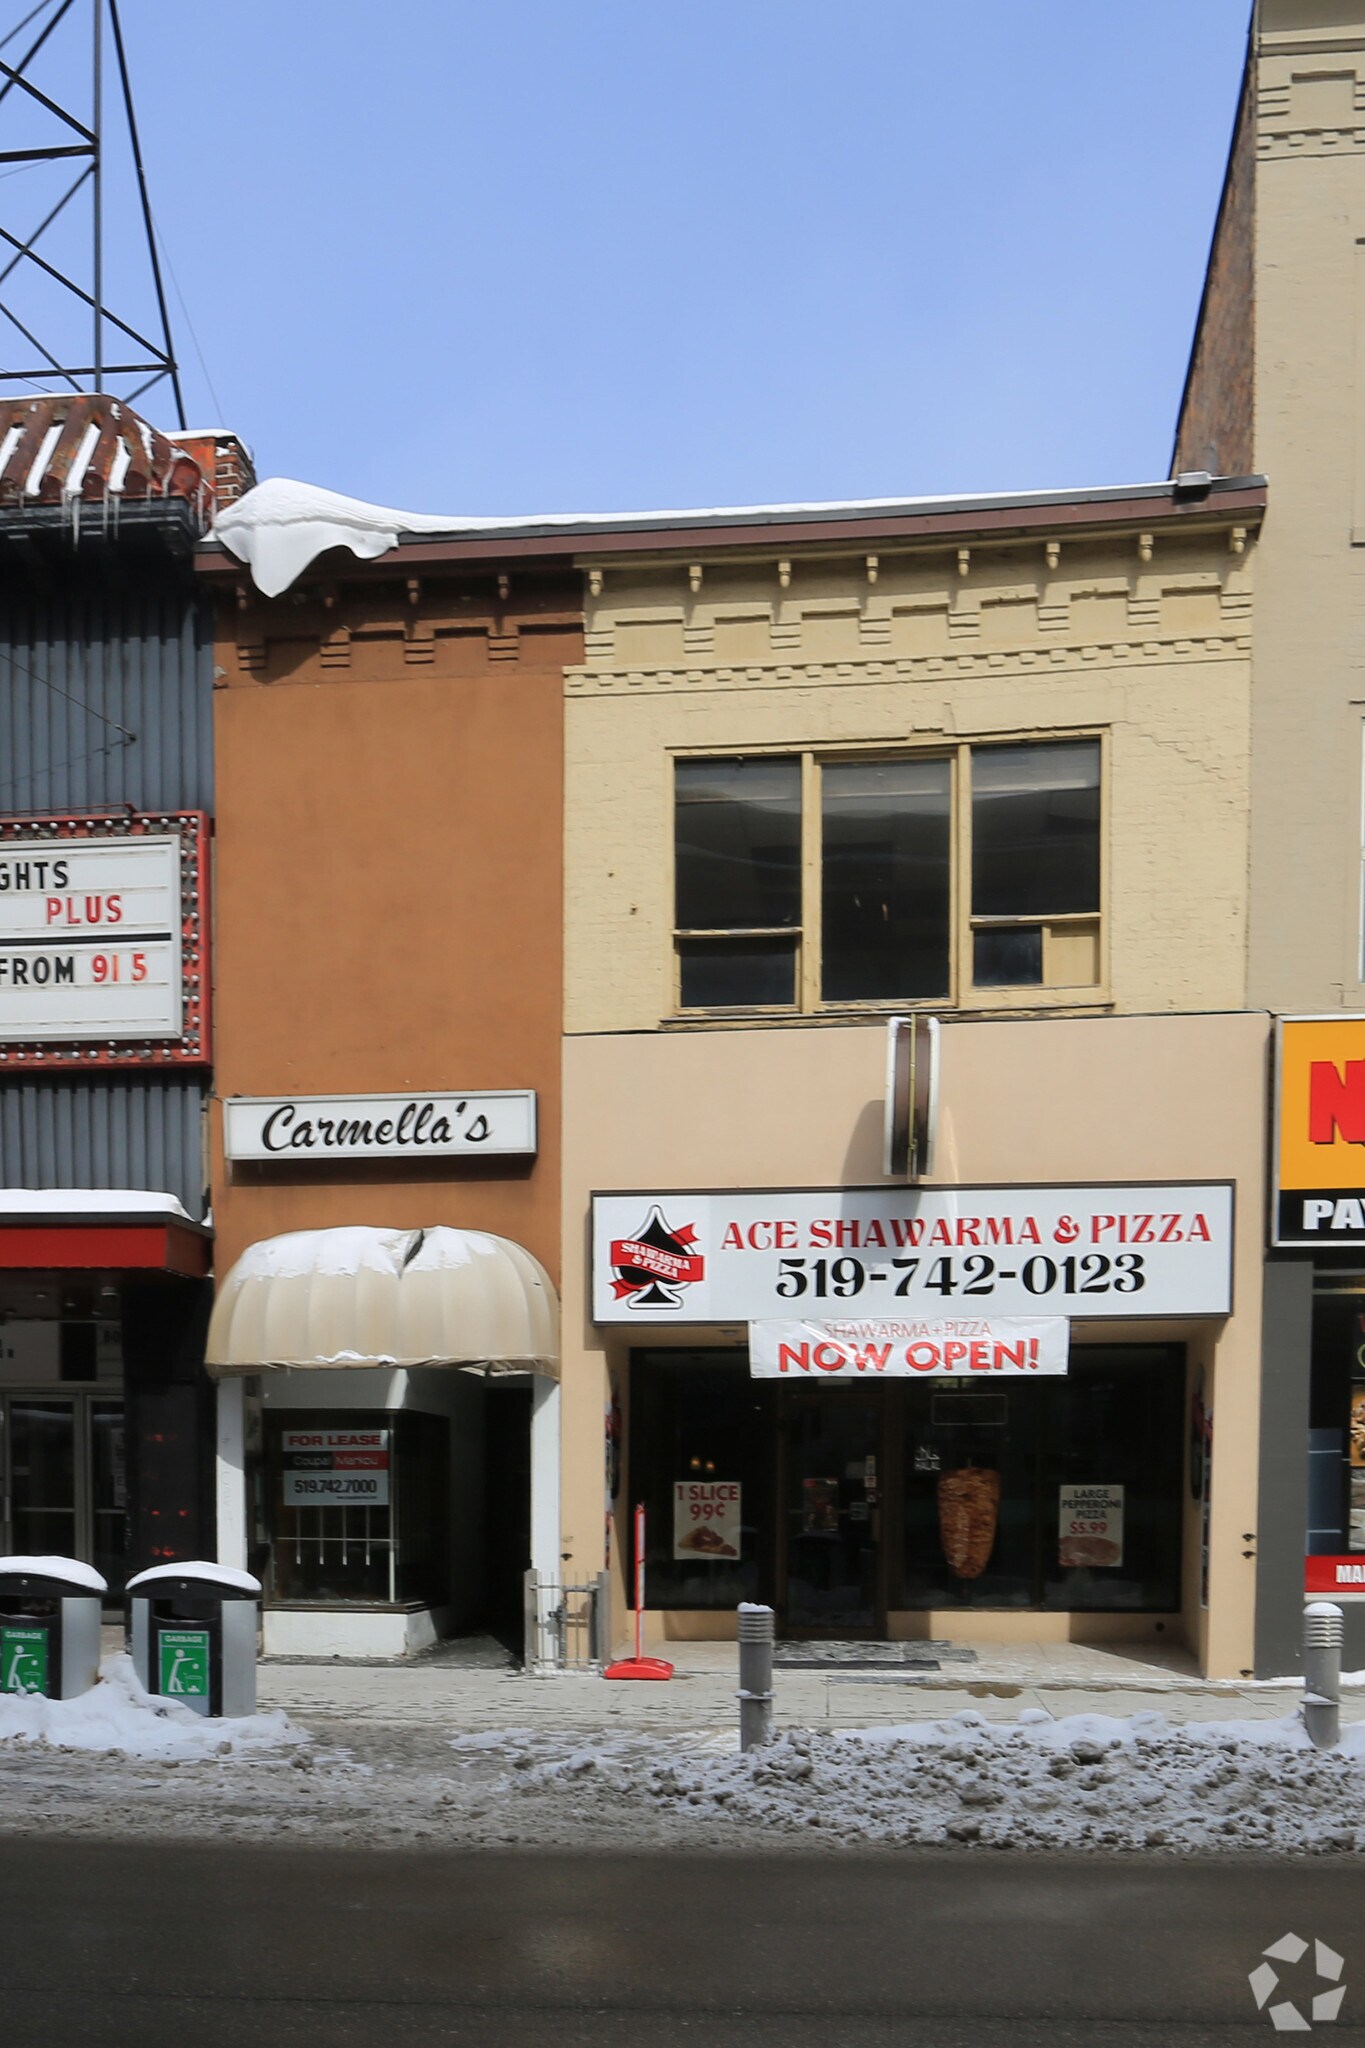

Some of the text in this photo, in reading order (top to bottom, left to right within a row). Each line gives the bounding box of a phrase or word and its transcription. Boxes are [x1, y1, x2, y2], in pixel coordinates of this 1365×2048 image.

[0, 861, 69, 890] GHTS
[46, 895, 123, 925] PLUS
[262, 1101, 492, 1151] Carmella's
[1302, 1198, 1365, 1231] PA
[720, 1213, 1213, 1250] ACE SHAWARMA & PIZZA
[620, 1242, 691, 1270] SHAWARMA
[642, 1257, 679, 1278] PIZZA
[776, 1254, 1146, 1298] 519-742-0123
[824, 1322, 930, 1338] SHAWARMA
[946, 1321, 993, 1336] PIZZA
[778, 1338, 1040, 1372] NOW OPEN!
[288, 1434, 381, 1446] FOR LEASE
[294, 1479, 377, 1494] 519.742.7000
[677, 1485, 739, 1500] 1 SLICE
[1073, 1489, 1110, 1499] LARGE
[1336, 1564, 1365, 1583] MA
[164, 1634, 203, 1643] GARBAGE
